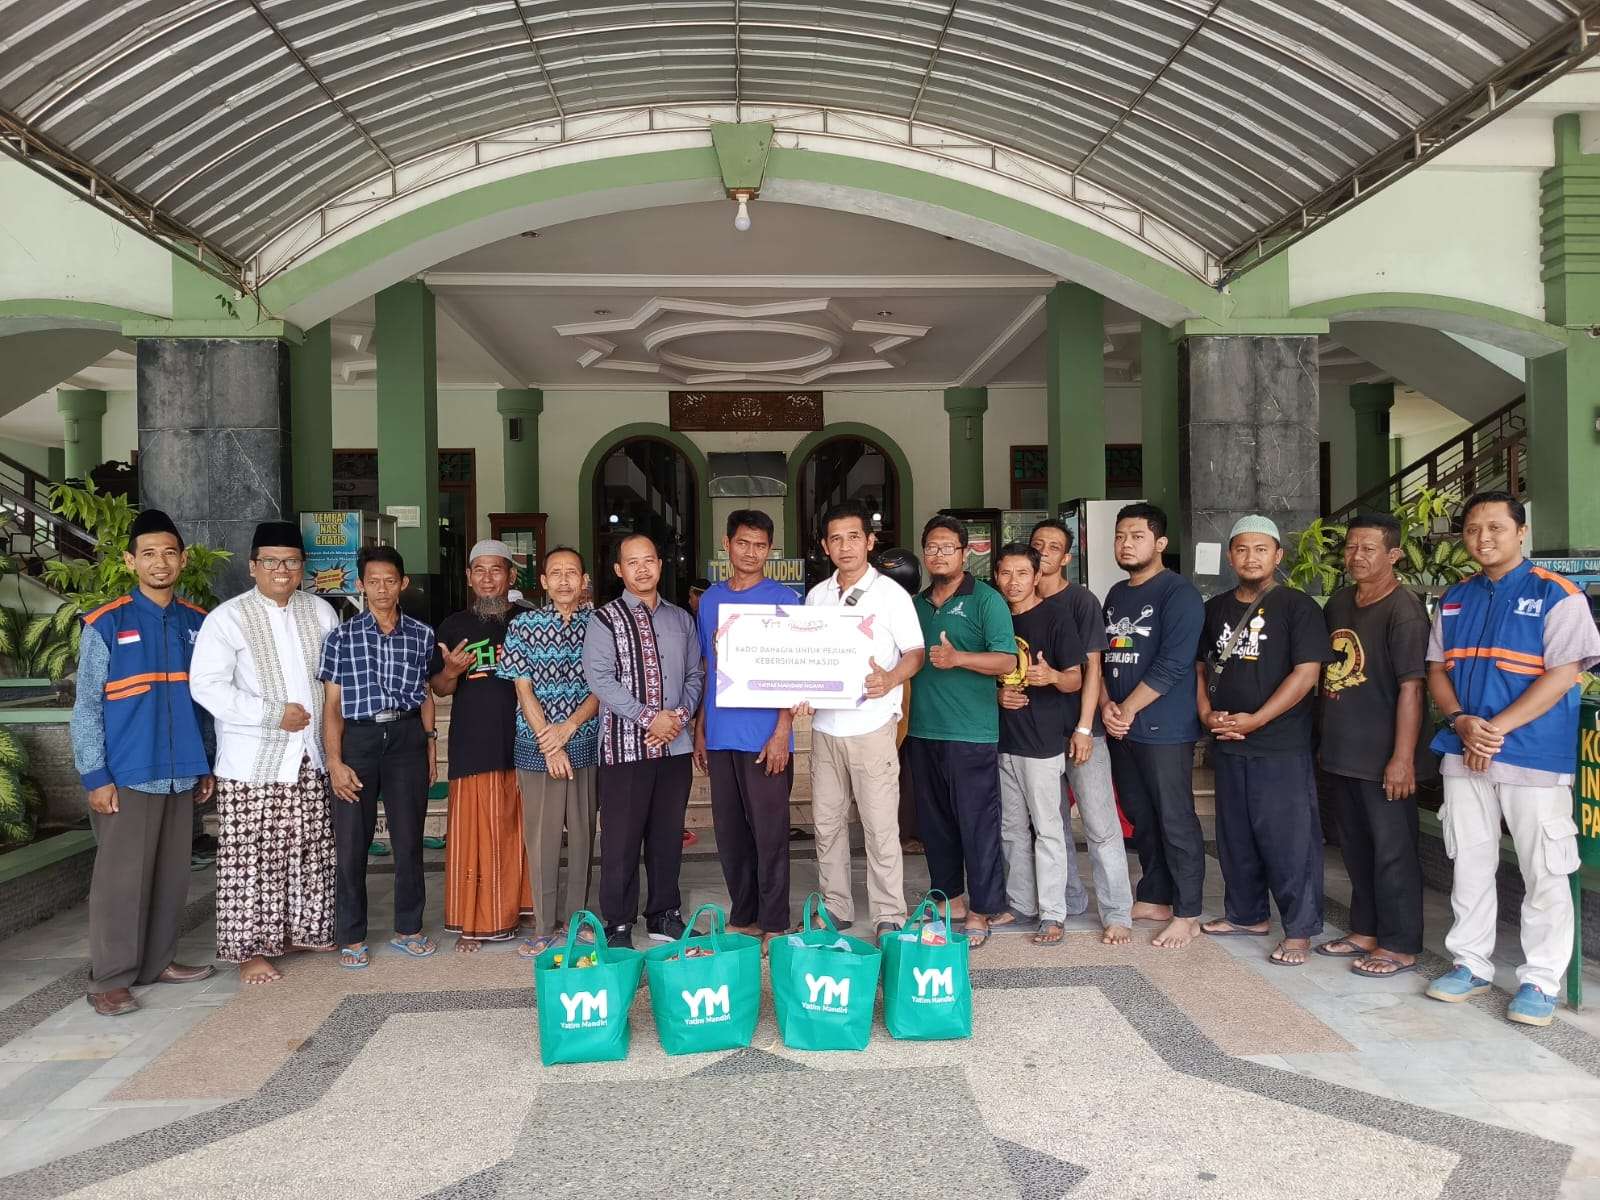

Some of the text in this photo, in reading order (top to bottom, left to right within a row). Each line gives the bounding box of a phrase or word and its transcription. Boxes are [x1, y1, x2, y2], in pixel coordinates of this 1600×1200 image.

[314, 512, 347, 523] TEMPAT
[320, 524, 342, 534] NASI
[315, 535, 347, 546] GRATIS
[711, 560, 803, 581] TEM WUDHU
[1553, 560, 1580, 573] SEPATU
[1518, 597, 1543, 614] YM
[755, 657, 839, 666] KEBERSIHAN MASJID
[913, 966, 954, 996] YM
[805, 973, 850, 1006] YM
[560, 989, 608, 1022] YM
[682, 985, 730, 1018] YM
[911, 994, 955, 1004] Yatim Mandiri
[801, 1001, 849, 1014] Yatim Mandiri
[560, 1019, 608, 1030] Yatim Mandiri
[684, 1013, 731, 1025] Yatim Mandiri
